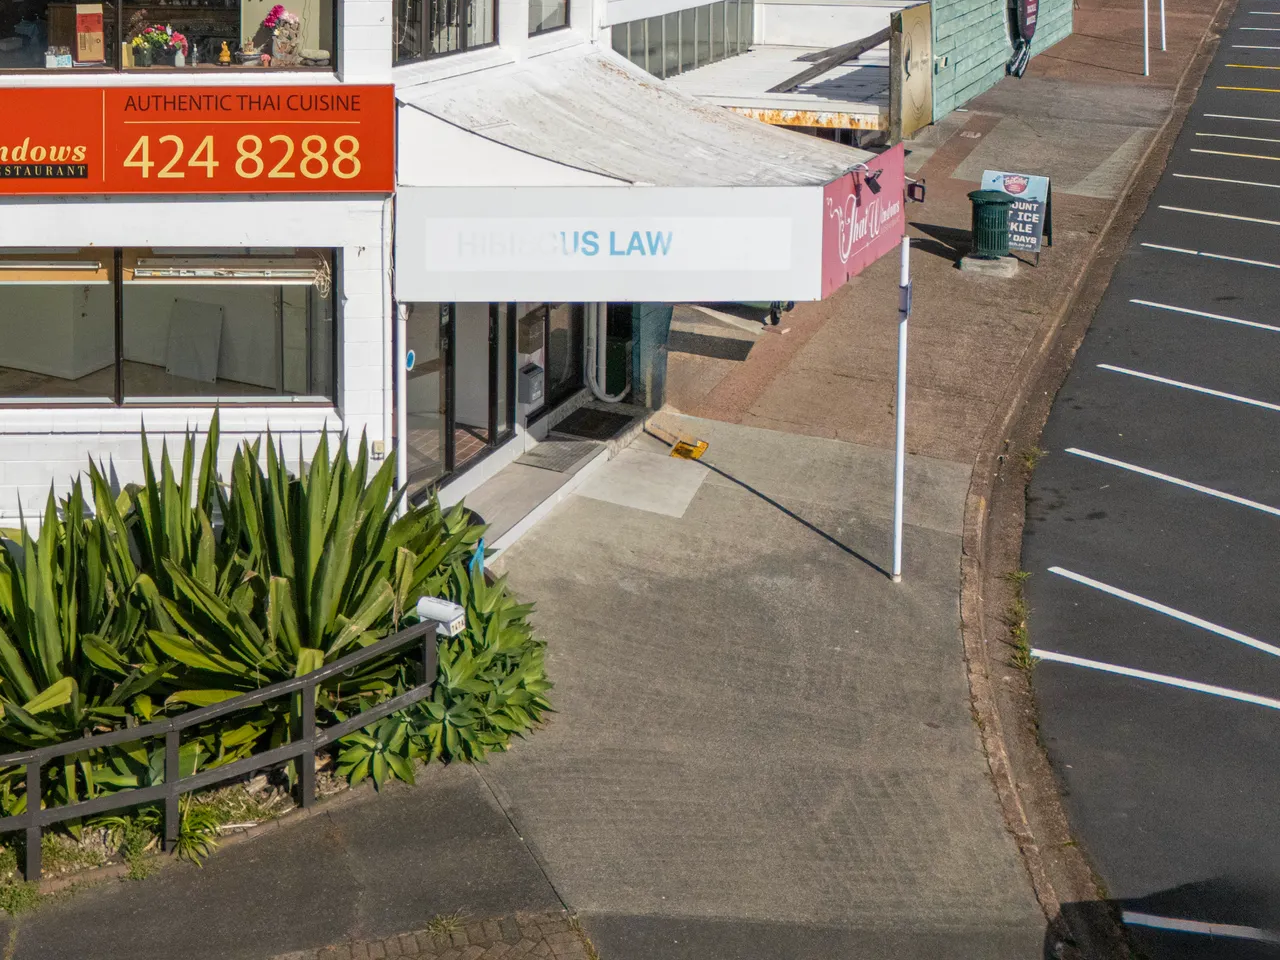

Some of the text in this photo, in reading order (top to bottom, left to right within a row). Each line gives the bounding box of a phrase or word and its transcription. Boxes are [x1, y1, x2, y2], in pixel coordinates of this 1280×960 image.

[124, 94, 361, 112] AUTHENTIC THAI CUISINE
[123, 134, 362, 179] 424 8288
[1010, 201, 1039, 211] OUNT
[1017, 211, 1040, 223] ICE
[1009, 222, 1033, 233] KLE
[609, 230, 673, 256] LAW
[1013, 234, 1037, 244] DAYS
